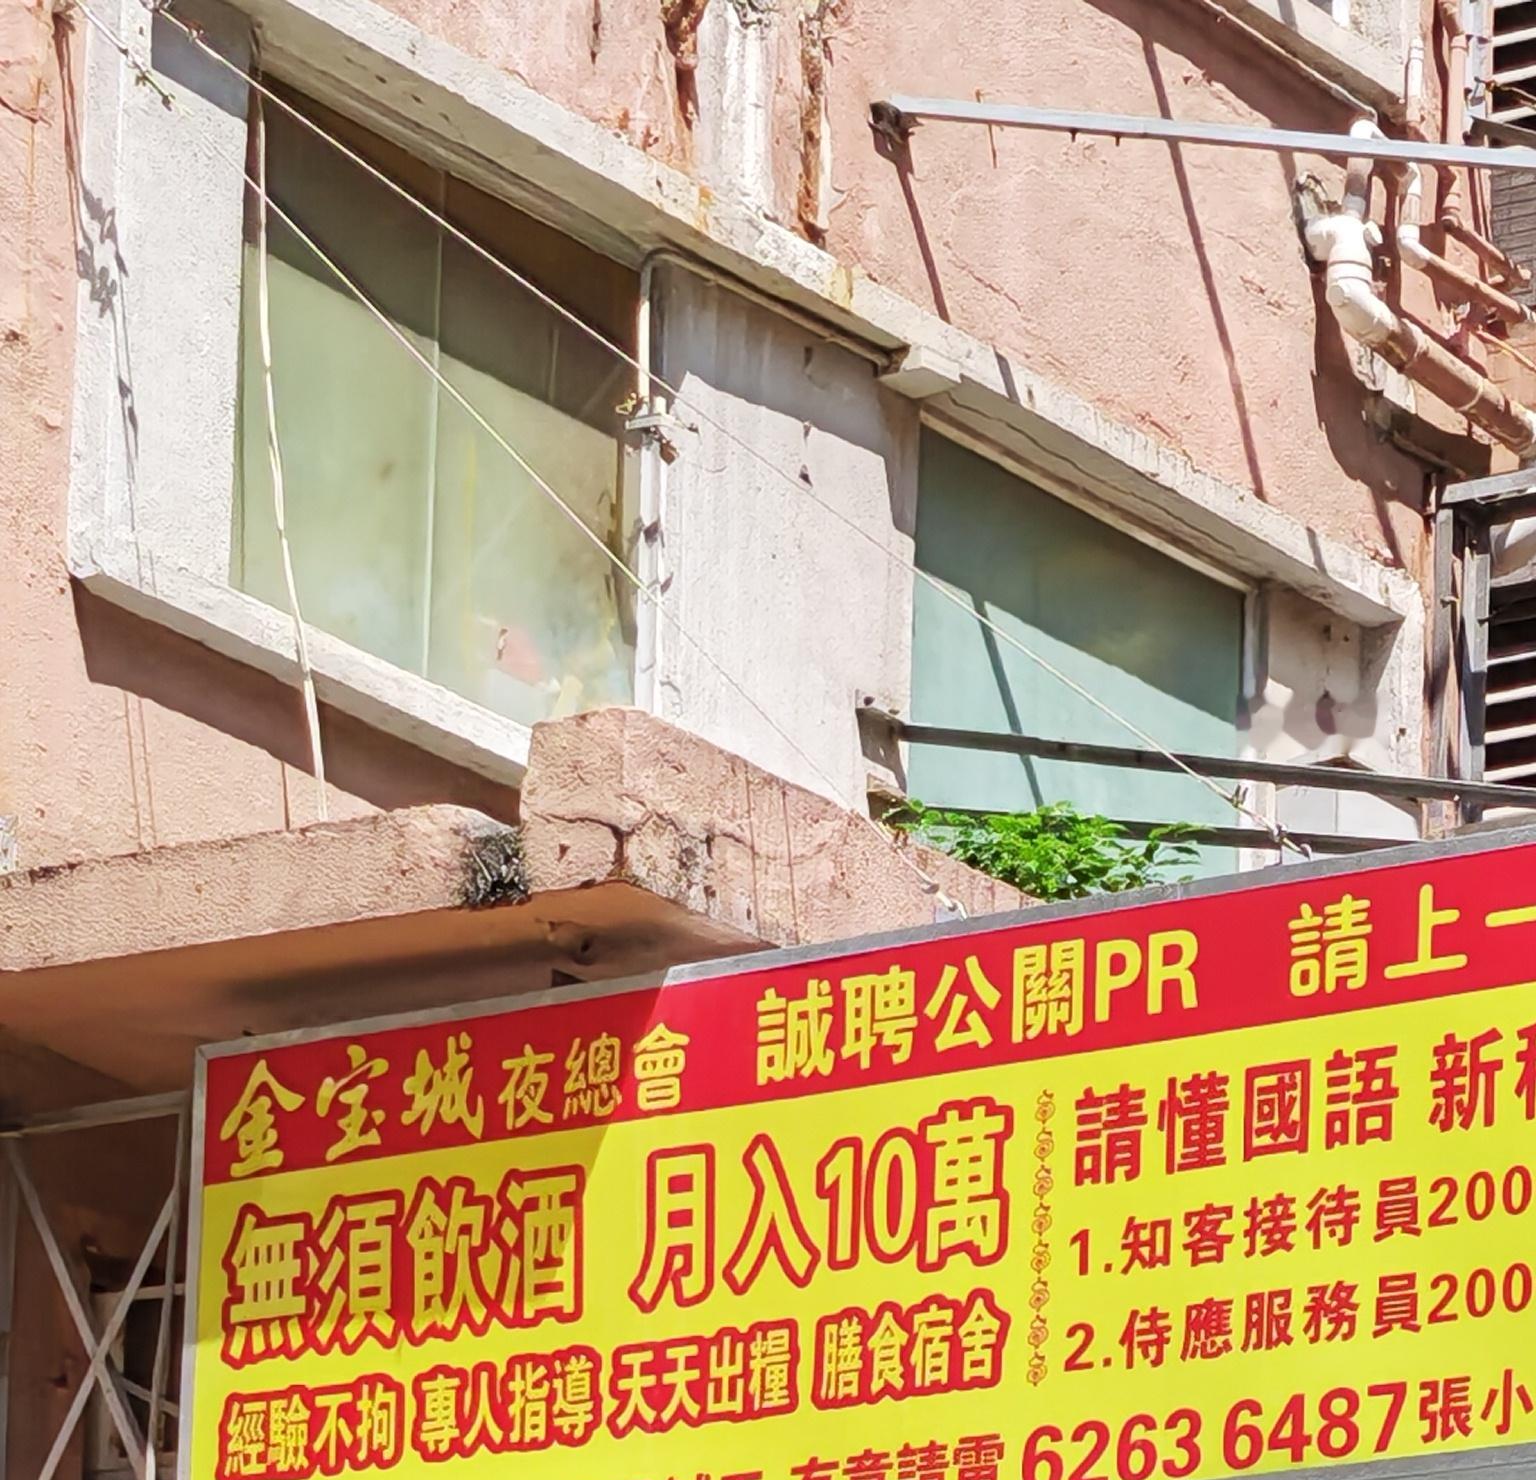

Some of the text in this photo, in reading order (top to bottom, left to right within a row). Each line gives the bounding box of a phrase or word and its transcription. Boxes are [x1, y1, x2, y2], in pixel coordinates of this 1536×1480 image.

[757, 929, 1200, 1085] 誠聘公關PR
[1073, 1044, 1400, 1188] 請懂國語
[221, 1096, 1015, 1366] 無須飲酒 月入10萬
[411, 1348, 601, 1458] 專人指導
[607, 1318, 801, 1438] 天天出糧
[812, 1288, 1011, 1408] 膳食宿舍
[1222, 1382, 1412, 1472] 6487
